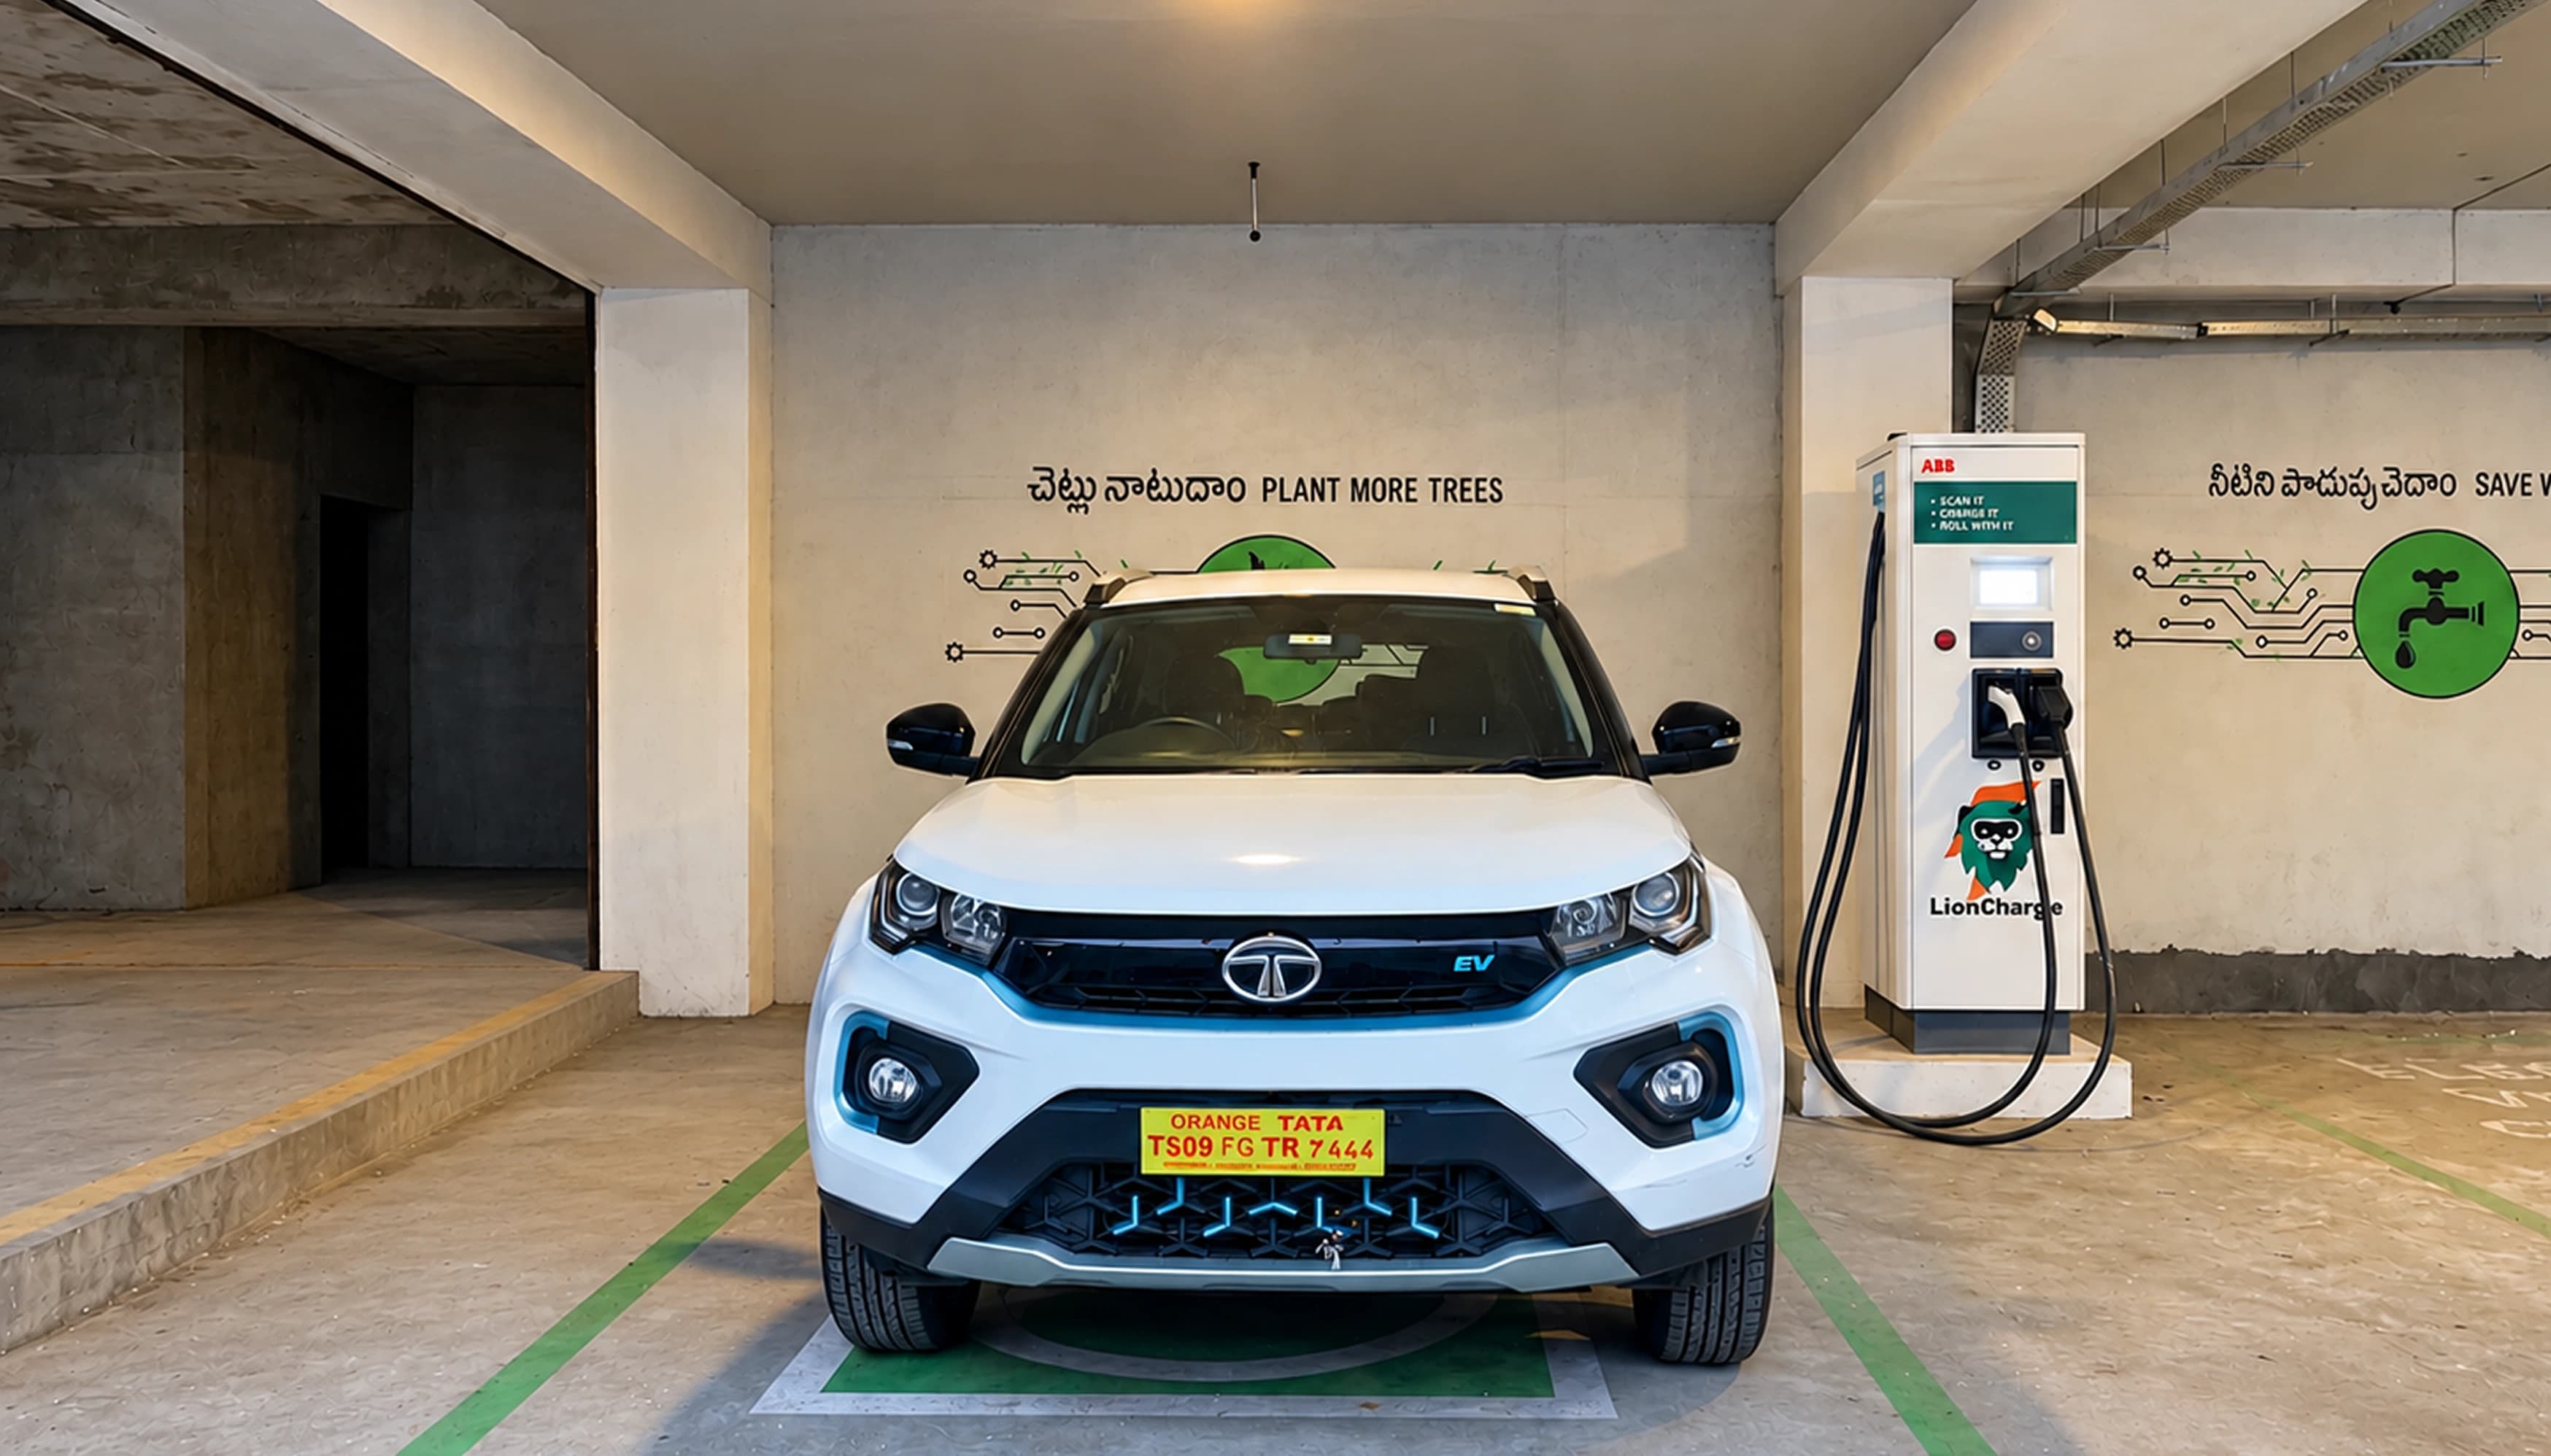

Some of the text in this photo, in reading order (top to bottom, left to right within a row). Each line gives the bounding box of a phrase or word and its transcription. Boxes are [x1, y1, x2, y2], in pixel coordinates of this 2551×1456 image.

[1921, 459, 1956, 473] ABB
[1104, 467, 1247, 503] నాటుదాం
[1262, 476, 1504, 503] PLANT MORE TREES
[2474, 472, 2533, 497] SAVE
[1940, 496, 1984, 506] SCAN IT
[1988, 508, 1999, 519] IT
[1971, 521, 2000, 531] WITH
[2002, 521, 2014, 531] IT
[1453, 954, 1496, 972] EV
[1170, 1114, 1344, 1132] ORANGE TATA
[1147, 1134, 1214, 1158] TS09
[1261, 1136, 1300, 1159] TR
